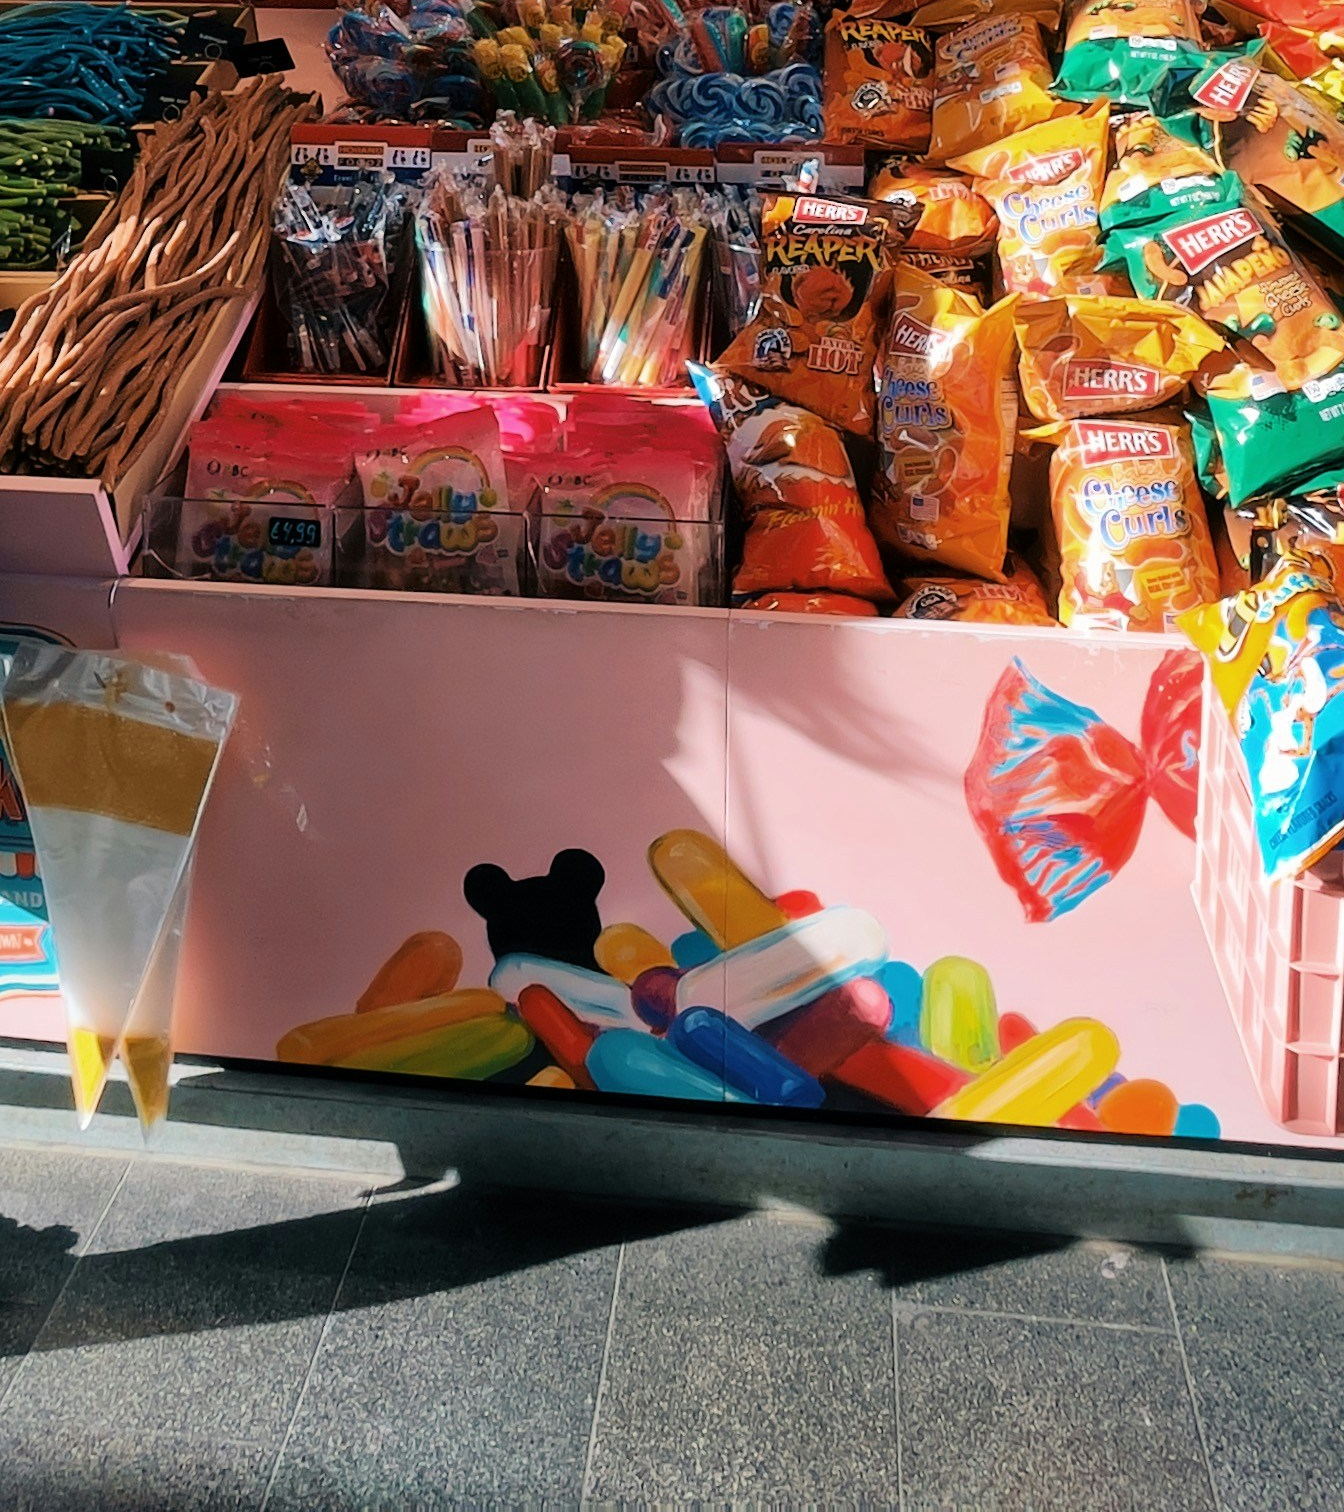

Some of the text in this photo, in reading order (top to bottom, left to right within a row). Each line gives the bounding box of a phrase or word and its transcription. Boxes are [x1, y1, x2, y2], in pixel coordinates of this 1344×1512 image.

[841, 20, 932, 51] REAPER
[1003, 184, 1090, 219] Cheese
[1019, 204, 1097, 245] Curls
[1178, 212, 1253, 258] HERR'S
[763, 237, 883, 272] REAPER
[808, 345, 865, 373] HOT
[1074, 366, 1148, 392] HERR'S
[1087, 429, 1163, 454] HERR'S
[1082, 477, 1182, 515] Cheese
[270, 522, 317, 544] €4,99
[1099, 506, 1188, 552] Curls
